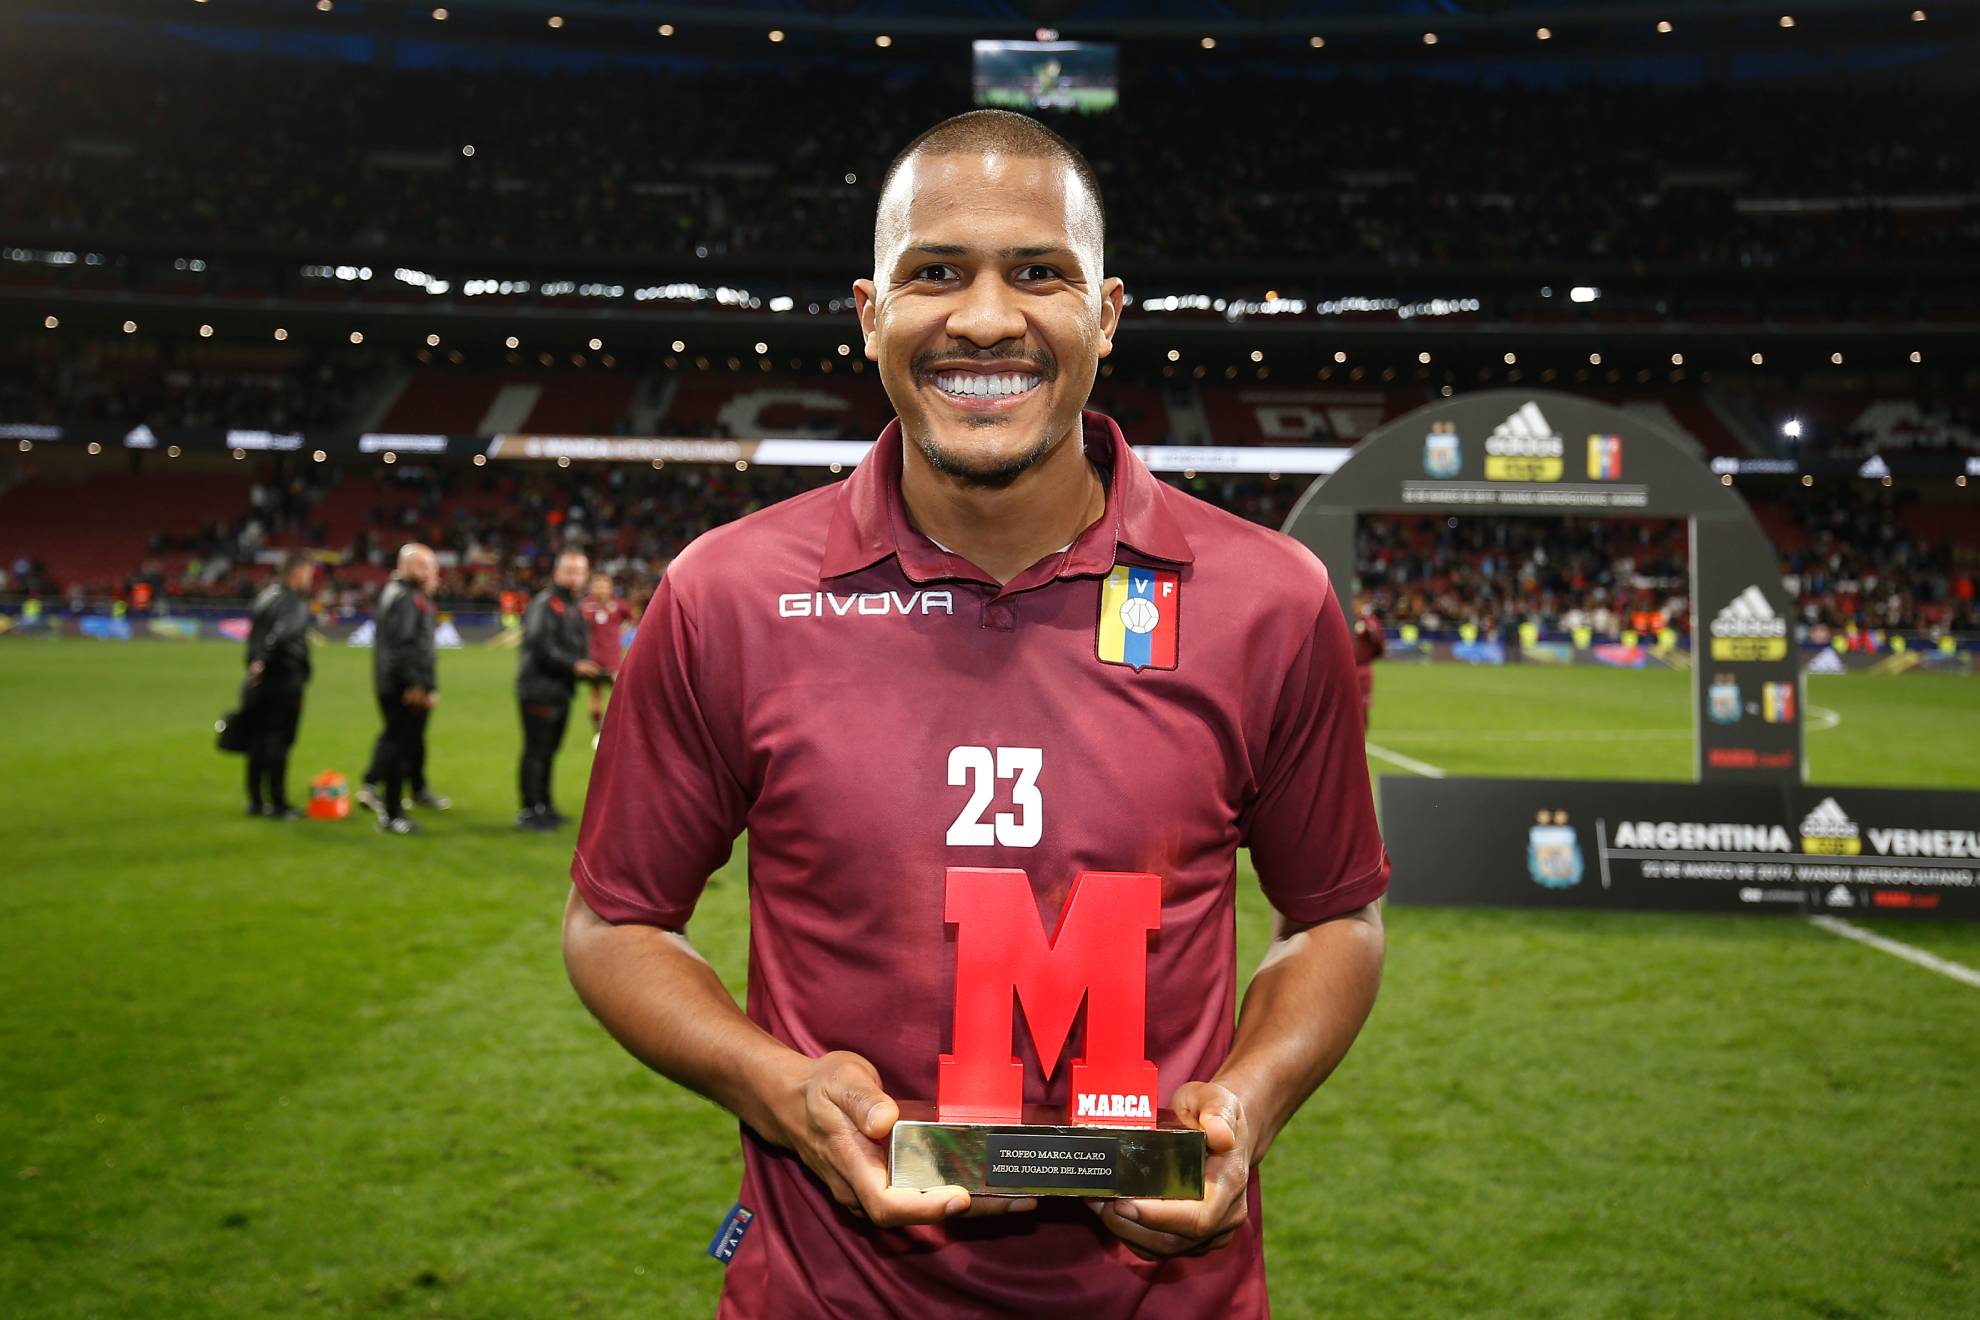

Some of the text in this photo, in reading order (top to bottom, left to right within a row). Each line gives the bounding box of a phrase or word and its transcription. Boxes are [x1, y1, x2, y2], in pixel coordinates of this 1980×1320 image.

[779, 591, 954, 618] GIVOVA
[945, 745, 1044, 848] 23
[1614, 821, 1792, 852] ARGENTINA
[1077, 1093, 1152, 1117] MARCA
[1000, 1150, 1106, 1160] TROFEO MARCA CLARO
[992, 1165, 1112, 1175] MEJOR JUGADOR DEL PARTIDO
